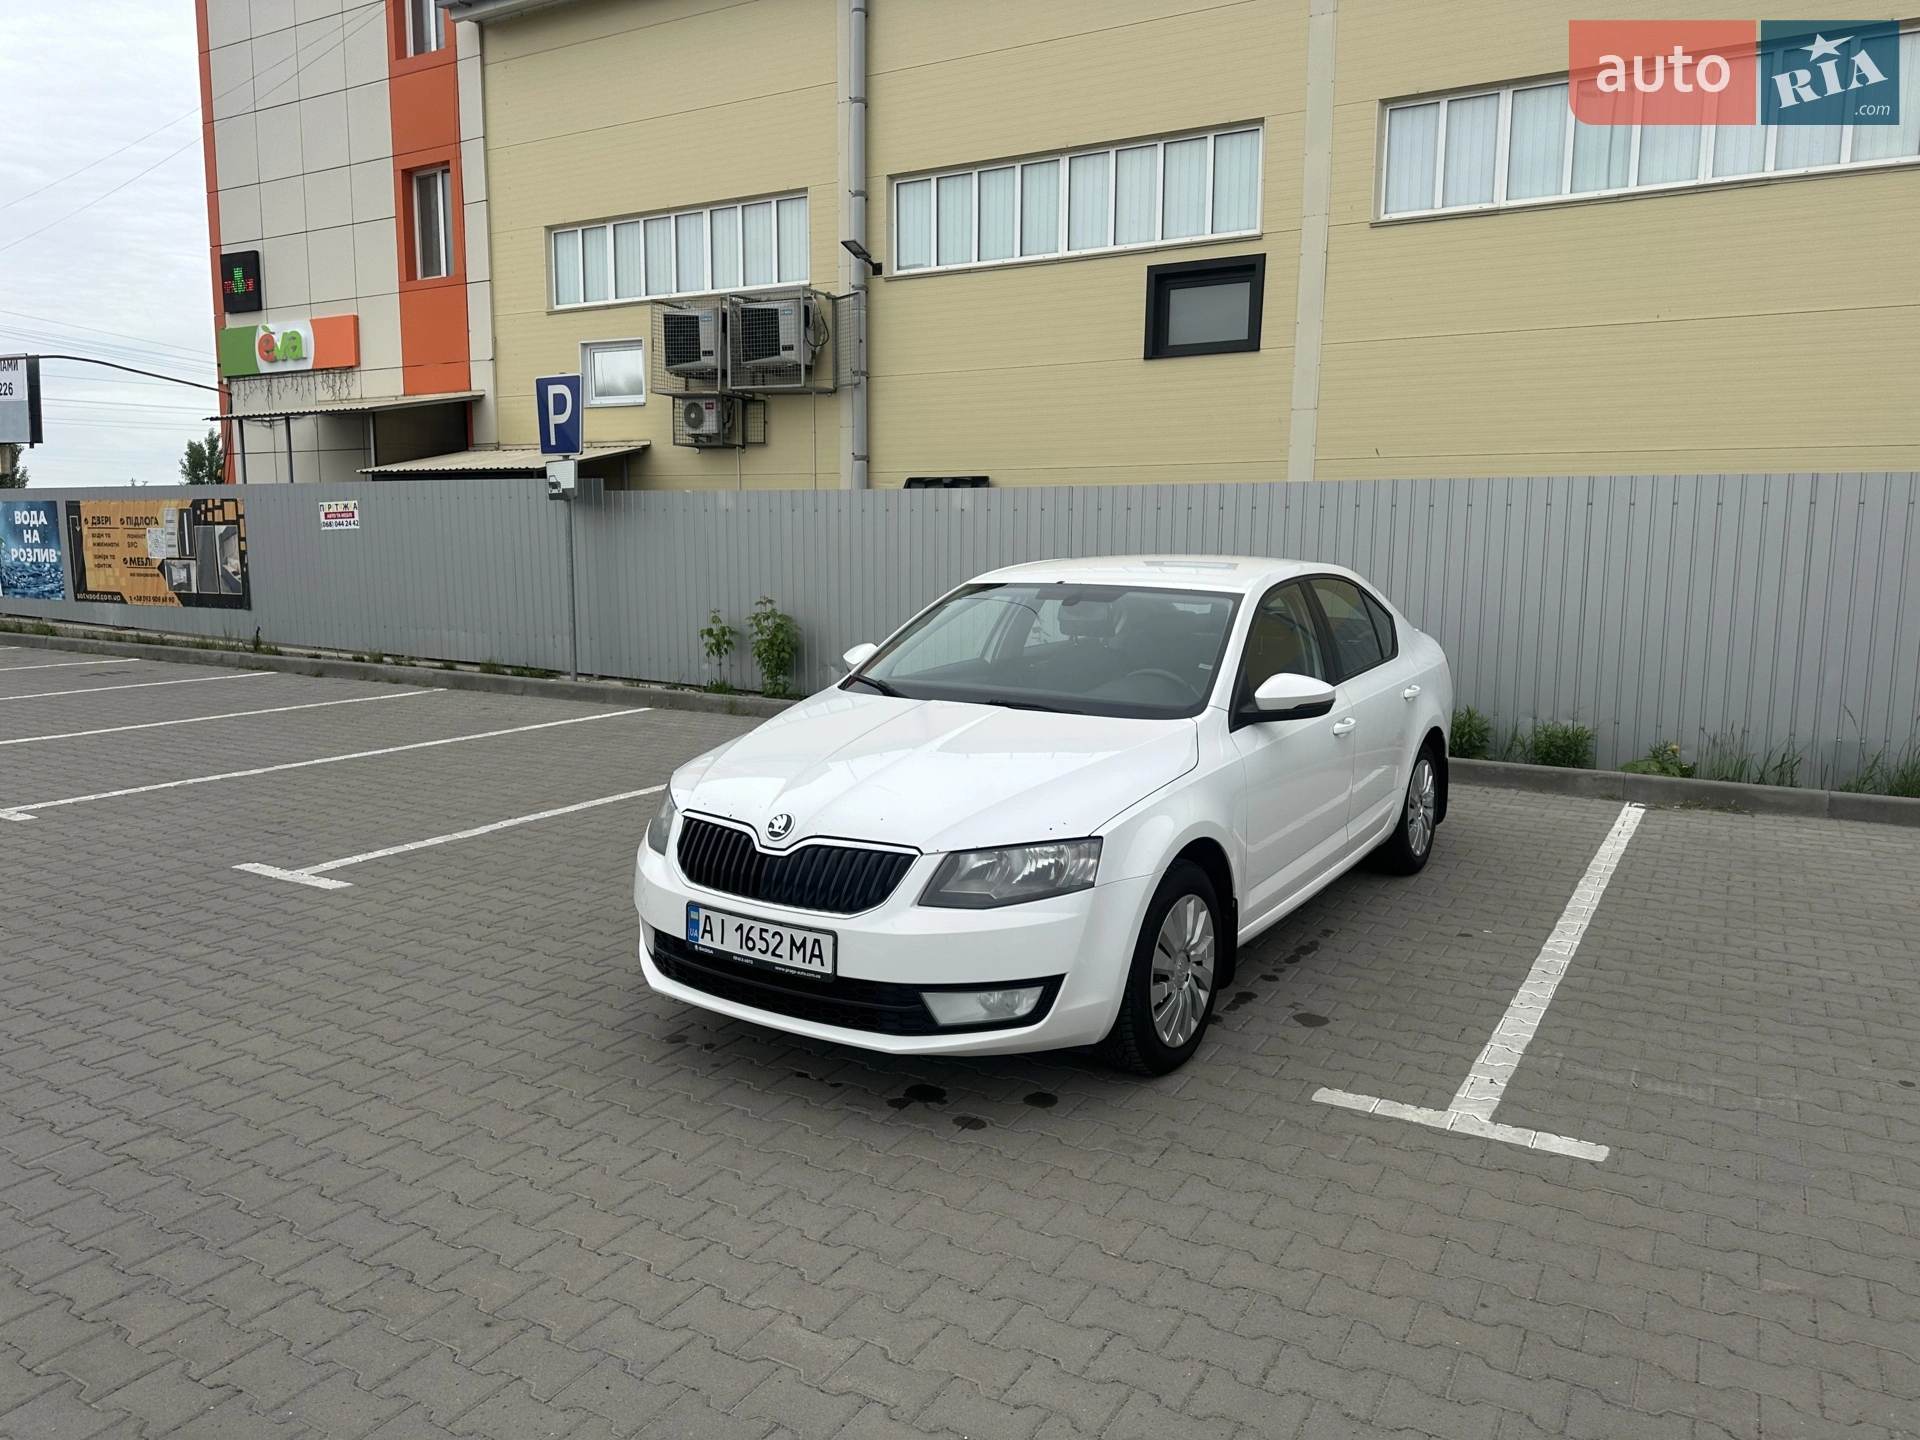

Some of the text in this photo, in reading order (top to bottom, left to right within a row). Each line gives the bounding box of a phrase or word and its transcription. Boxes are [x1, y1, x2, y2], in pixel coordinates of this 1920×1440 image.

[547, 384, 573, 446] P
[14, 510, 48, 527] ВОДА
[91, 516, 112, 526] ДВЕРІ
[126, 516, 159, 527] ПІДЛОГА
[23, 529, 41, 544] НА
[11, 548, 57, 563] РОЗЛИВ
[129, 557, 153, 567] МЕБЛІ
[689, 928, 698, 937] UA
[701, 914, 825, 967] AI 1652 MA
